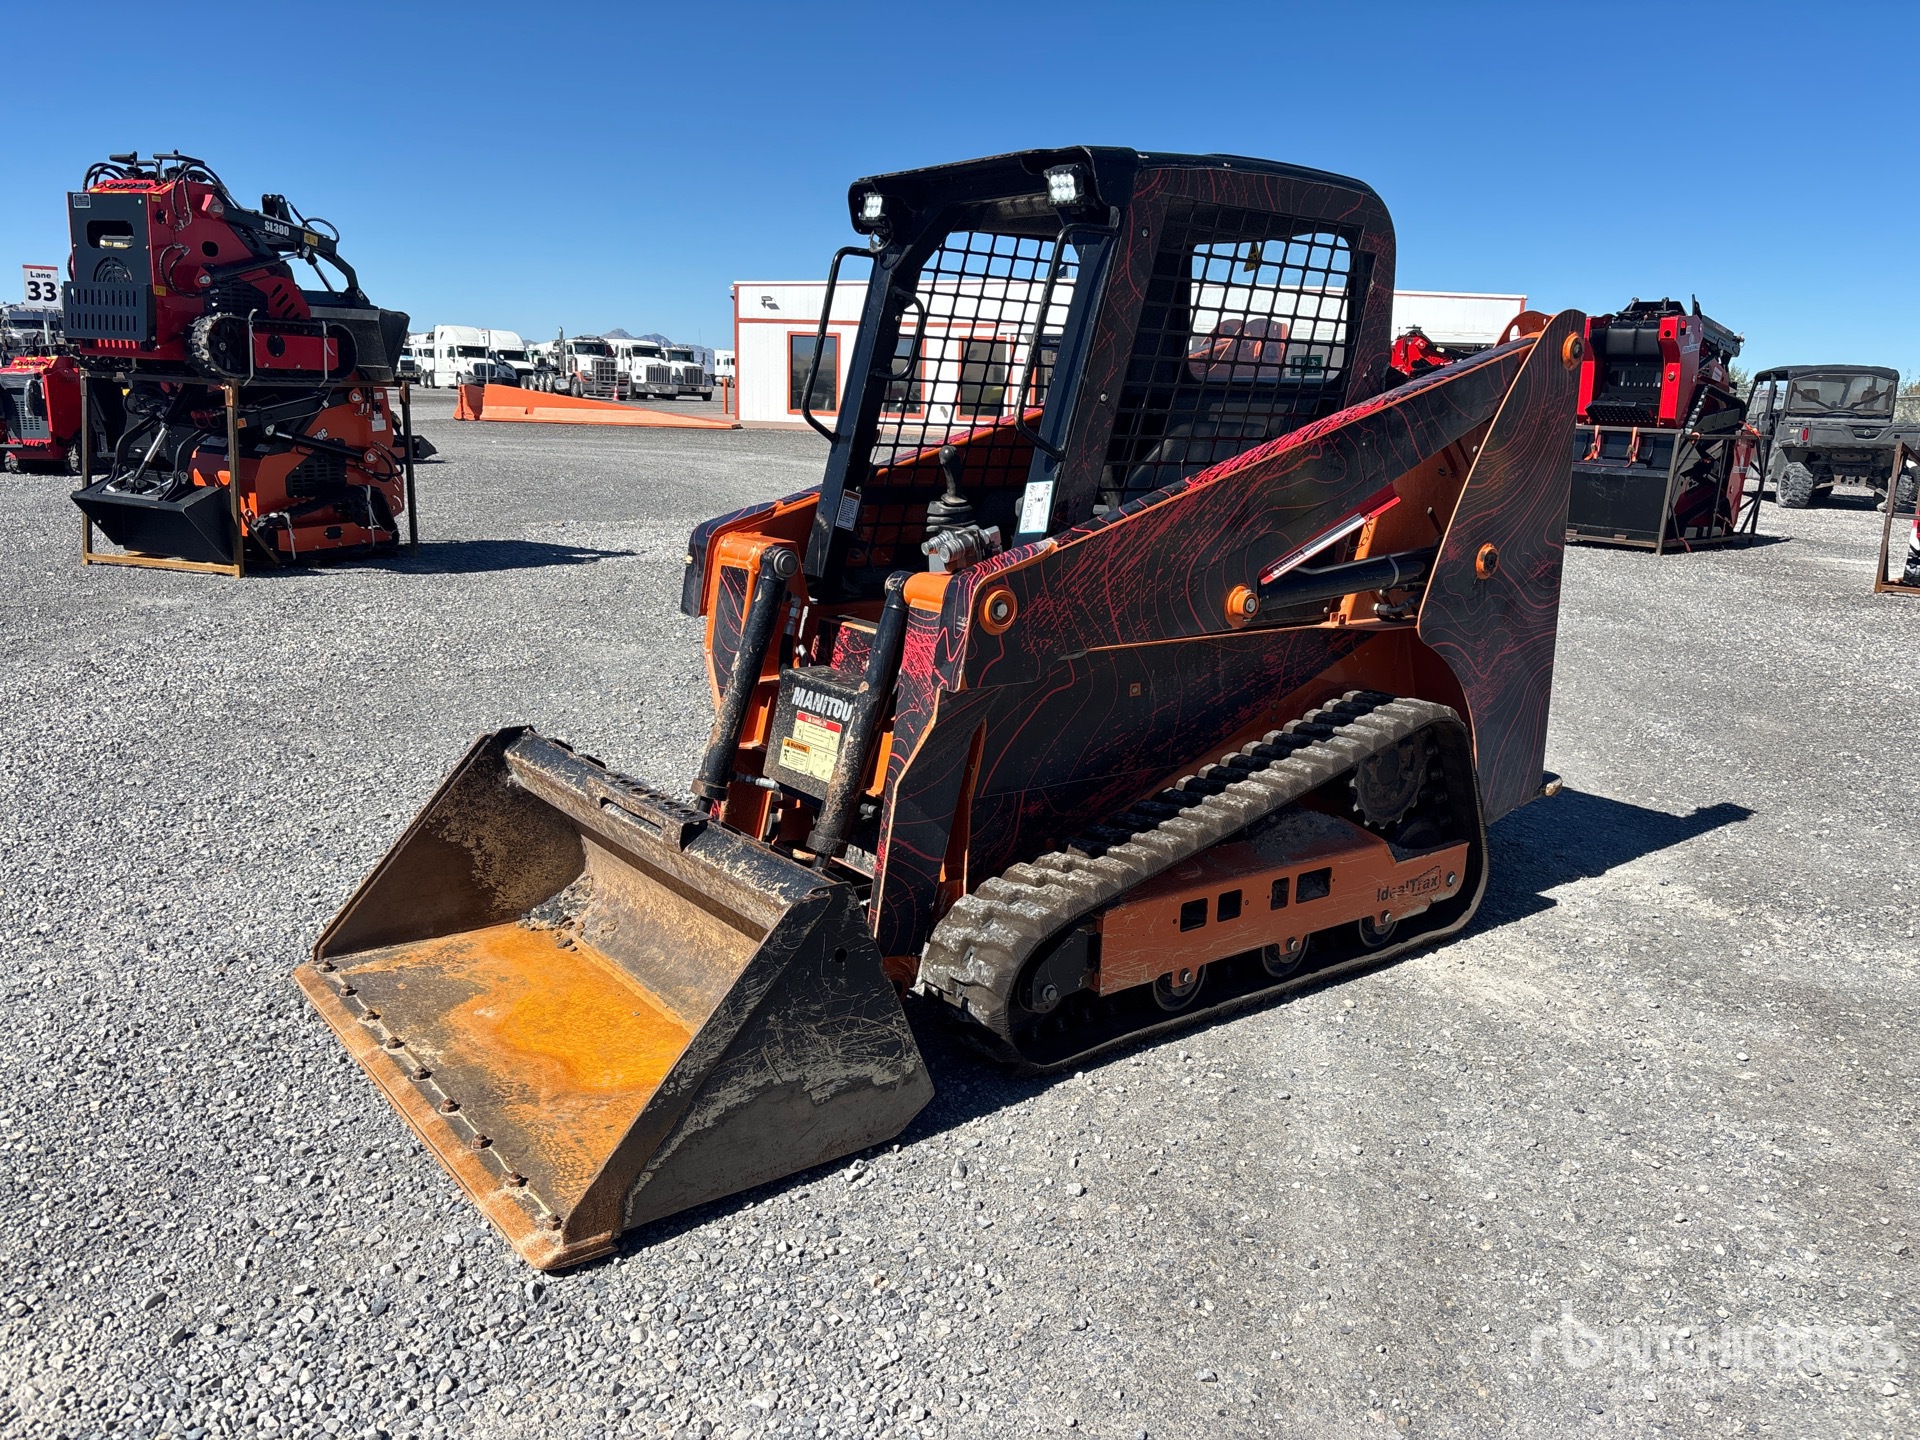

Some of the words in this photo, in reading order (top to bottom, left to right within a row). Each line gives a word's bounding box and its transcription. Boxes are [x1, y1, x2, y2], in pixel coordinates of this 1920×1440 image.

[264, 220, 290, 237] SL380
[30, 271, 52, 279] Lane
[27, 280, 57, 302] 33
[791, 686, 854, 722] MANITOU
[789, 740, 808, 752] WARNING
[1376, 876, 1439, 902] IdealTrax
